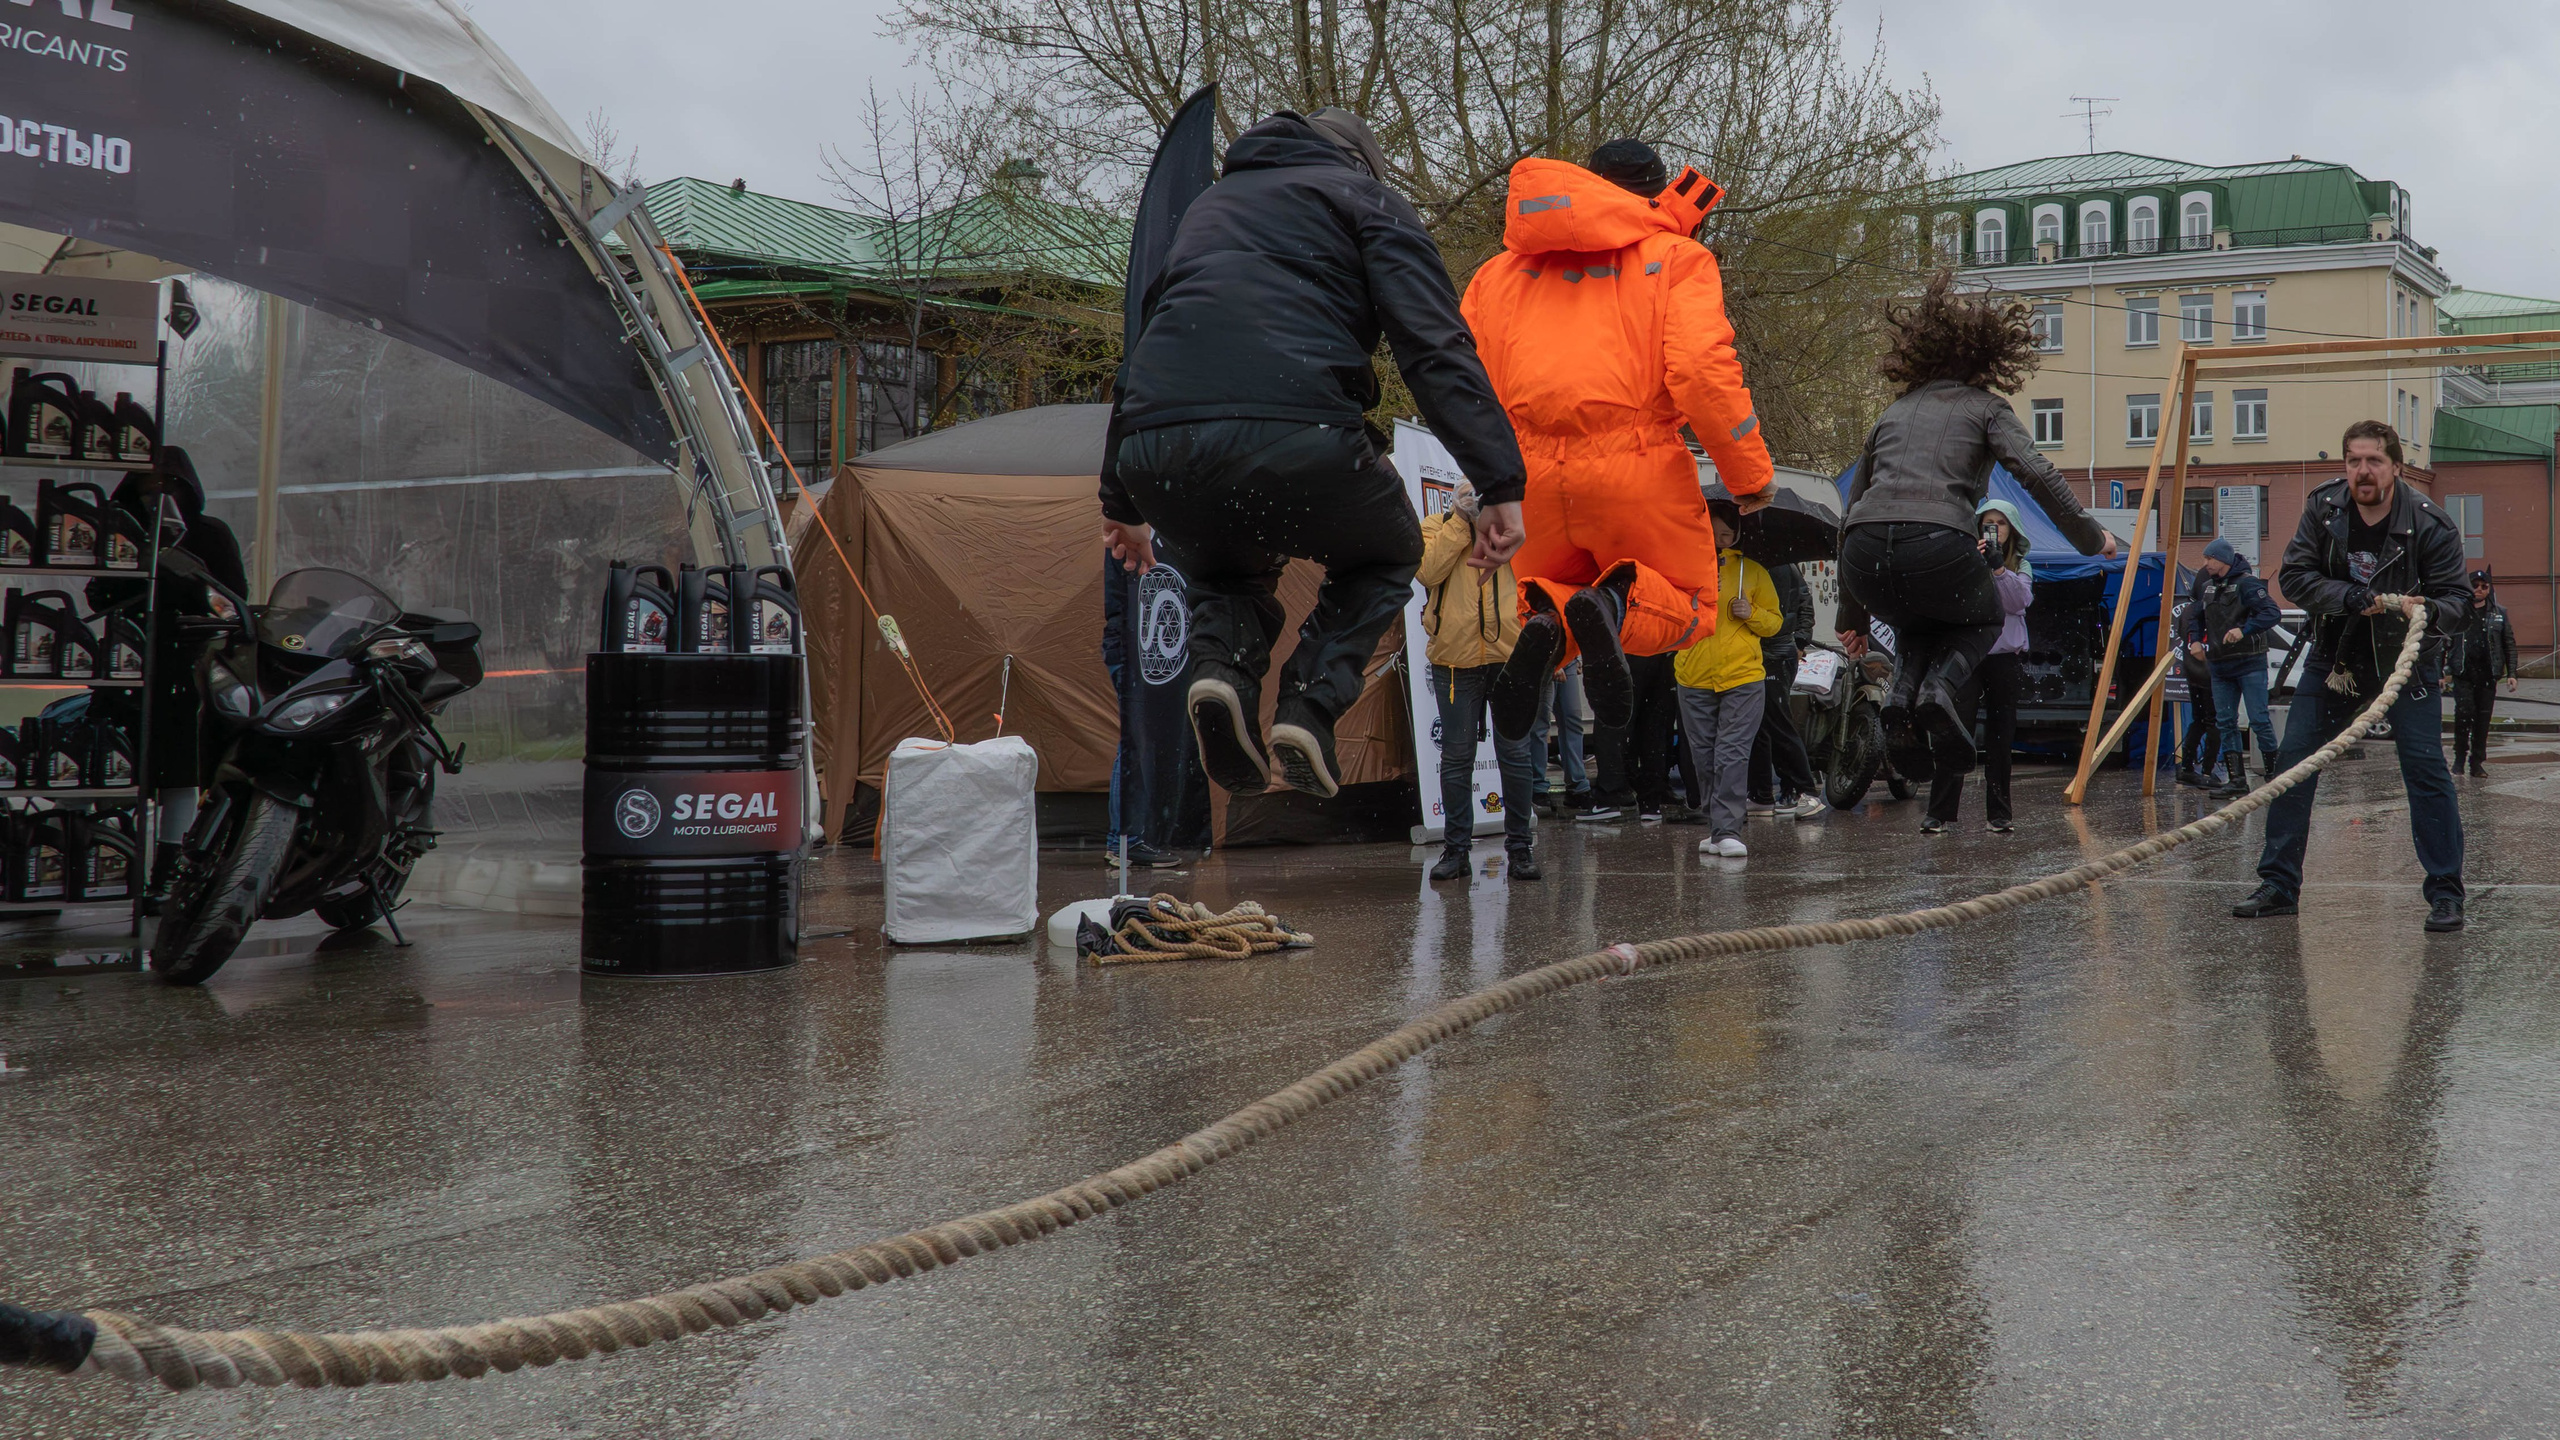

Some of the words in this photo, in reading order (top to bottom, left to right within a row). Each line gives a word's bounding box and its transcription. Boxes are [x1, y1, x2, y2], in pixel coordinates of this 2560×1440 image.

[10, 293, 99, 316] SEGAL
[627, 611, 636, 639] SEGAL
[701, 613, 709, 640] SEGAL
[752, 612, 760, 640] SEGAL
[672, 792, 778, 820] SEGAL
[673, 826, 711, 836] MOTO
[713, 823, 777, 835] LUBRICANTS
